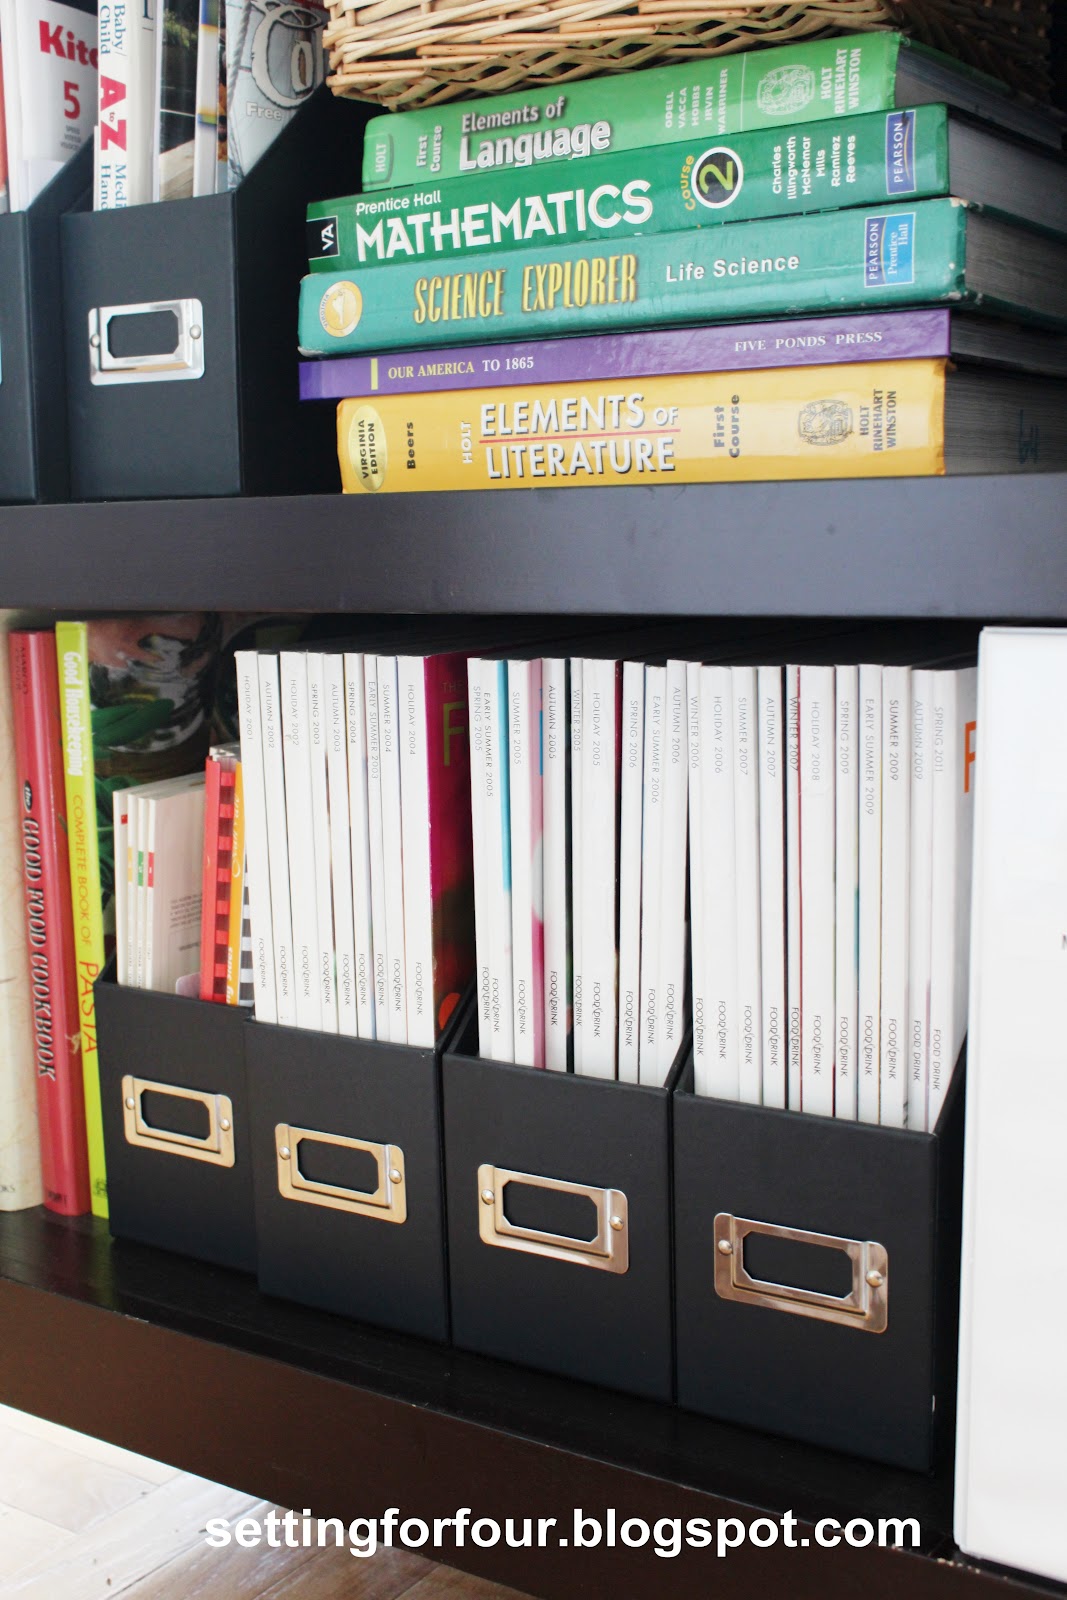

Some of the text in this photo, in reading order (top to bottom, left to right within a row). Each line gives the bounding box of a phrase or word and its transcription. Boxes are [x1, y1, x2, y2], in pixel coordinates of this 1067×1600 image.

[100, 5, 110, 55] Child
[112, 4, 127, 56] Baby/
[63, 81, 81, 120] 5
[100, 75, 127, 112] A
[705, 86, 713, 120] IRVIN
[718, 68, 729, 134] WARRINER
[821, 67, 832, 100] HOLT
[835, 48, 848, 114] RINEHART
[849, 48, 862, 109] WINSTON
[246, 102, 282, 121] Free
[461, 96, 566, 133] Elements of
[665, 91, 674, 128] ODELL
[678, 87, 688, 129] VACCA
[692, 85, 700, 126] HOBBS
[101, 119, 127, 151] Z
[375, 142, 387, 173] HOLT
[416, 135, 428, 167] First
[430, 125, 442, 172] Course
[459, 120, 611, 170] Language
[846, 135, 856, 183] Reeves
[894, 122, 903, 183] PEARSON
[680, 155, 733, 210] course 2
[772, 145, 782, 195] Charles
[787, 136, 796, 200] Illingworth
[802, 136, 811, 195] McNemar
[816, 149, 825, 177] Mills
[831, 136, 841, 187] Ramirez
[355, 190, 441, 216] Prentice Hall
[356, 180, 653, 262] MATHEMATICS
[321, 223, 334, 250] VA
[869, 222, 879, 280] PEARSON
[888, 231, 899, 275] Prentice
[898, 223, 908, 245] Hall
[413, 254, 800, 324] SCIENCE EXPLORER Life Science
[734, 331, 882, 352] FIVE PONDS PRESS
[388, 356, 534, 380] OUR AMERICA TO 1865
[480, 392, 678, 437] ELEMENTS OF
[712, 405, 725, 448] First
[729, 394, 740, 458] Course
[859, 405, 870, 436] HOLT
[872, 388, 883, 452] RINEHART
[886, 390, 897, 448] WINSTON
[358, 419, 368, 479] VIRGINIA
[367, 422, 378, 474] EDITION
[406, 422, 415, 469] Beers
[462, 421, 473, 464] HOLT
[486, 437, 676, 479] LITERATURE
[244, 675, 252, 714] HOLIDAY
[265, 682, 274, 721] AUTUMN
[311, 683, 319, 718] SPRING
[332, 684, 340, 725] AUTUMN
[348, 682, 356, 716] SPRING
[368, 682, 376, 708] EARLY
[383, 684, 392, 752] SUMMER 2004
[407, 685, 415, 726] HOLIDAY
[473, 686, 482, 721] SPRING
[369, 712, 378, 751] SUMMER
[484, 725, 492, 768] SUMMER
[629, 700, 638, 768] SPRING 2006
[651, 696, 661, 804] EARLY SUMMER 2006
[671, 687, 681, 764] AUTUMN 2006
[690, 696, 699, 768] WINTER 2006
[714, 696, 723, 774] HOLIDAY 2006
[738, 697, 748, 775] SUMMER 2007
[766, 698, 776, 778] AUTUMN 2007
[789, 697, 799, 771] WINTER 2007
[811, 701, 820, 781] HOLIDAY 2008
[840, 701, 849, 774] SPRING 2009
[889, 700, 899, 781] SUMMER 2009
[914, 700, 923, 780] AUTUMN 2009
[935, 706, 944, 772] SPRING 2011
[865, 699, 874, 815] EARLY SUMMER 2009
[73, 794, 92, 946] COMPLETE BOOK OF
[22, 786, 56, 1082] the GOOD FOOD COOKBOOK
